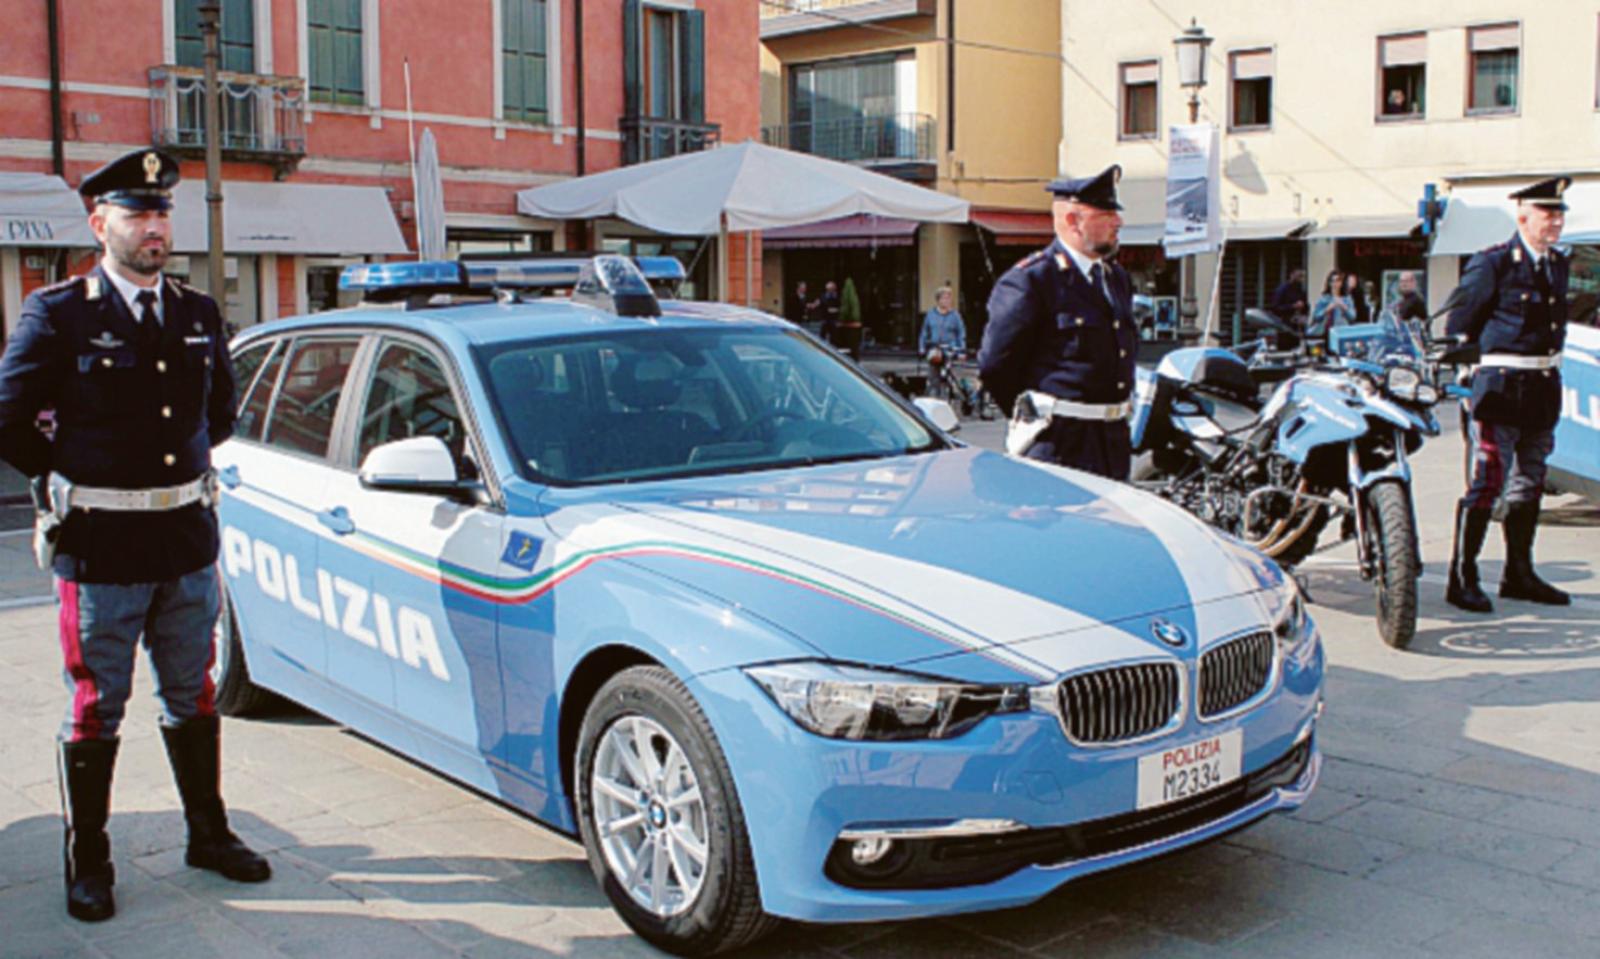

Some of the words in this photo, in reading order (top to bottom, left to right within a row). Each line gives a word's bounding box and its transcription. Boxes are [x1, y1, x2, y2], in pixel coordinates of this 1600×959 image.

[223, 525, 450, 682] POLIZIA
[1163, 738, 1220, 769] POLIZIA
[1162, 759, 1220, 800] M2334
